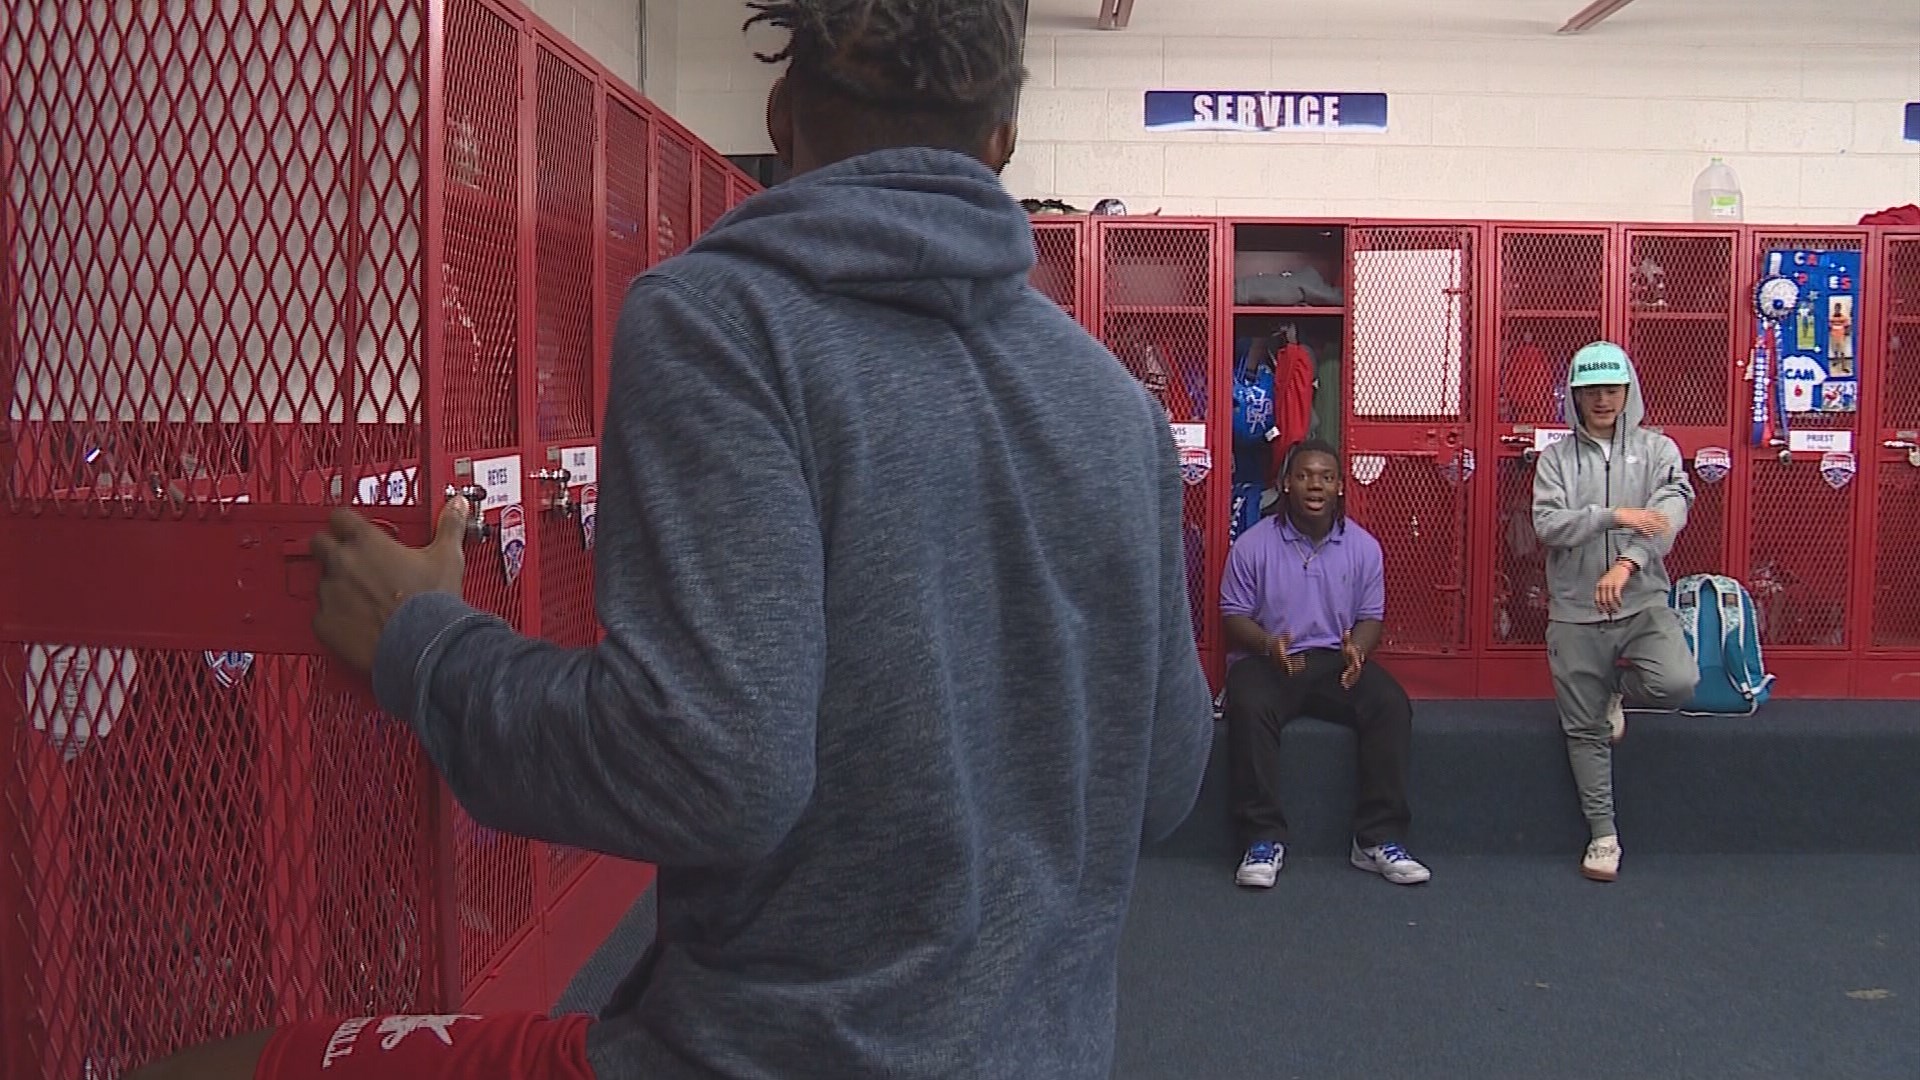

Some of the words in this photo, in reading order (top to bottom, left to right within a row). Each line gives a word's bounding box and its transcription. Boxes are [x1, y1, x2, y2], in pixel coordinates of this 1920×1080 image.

[1194, 94, 1340, 128] SERVICE
[1785, 368, 1815, 381] CAM
[1794, 384, 1803, 397] 6
[1806, 434, 1835, 443] PRIEST
[487, 468, 508, 487] REYES
[369, 478, 403, 505] MORE
